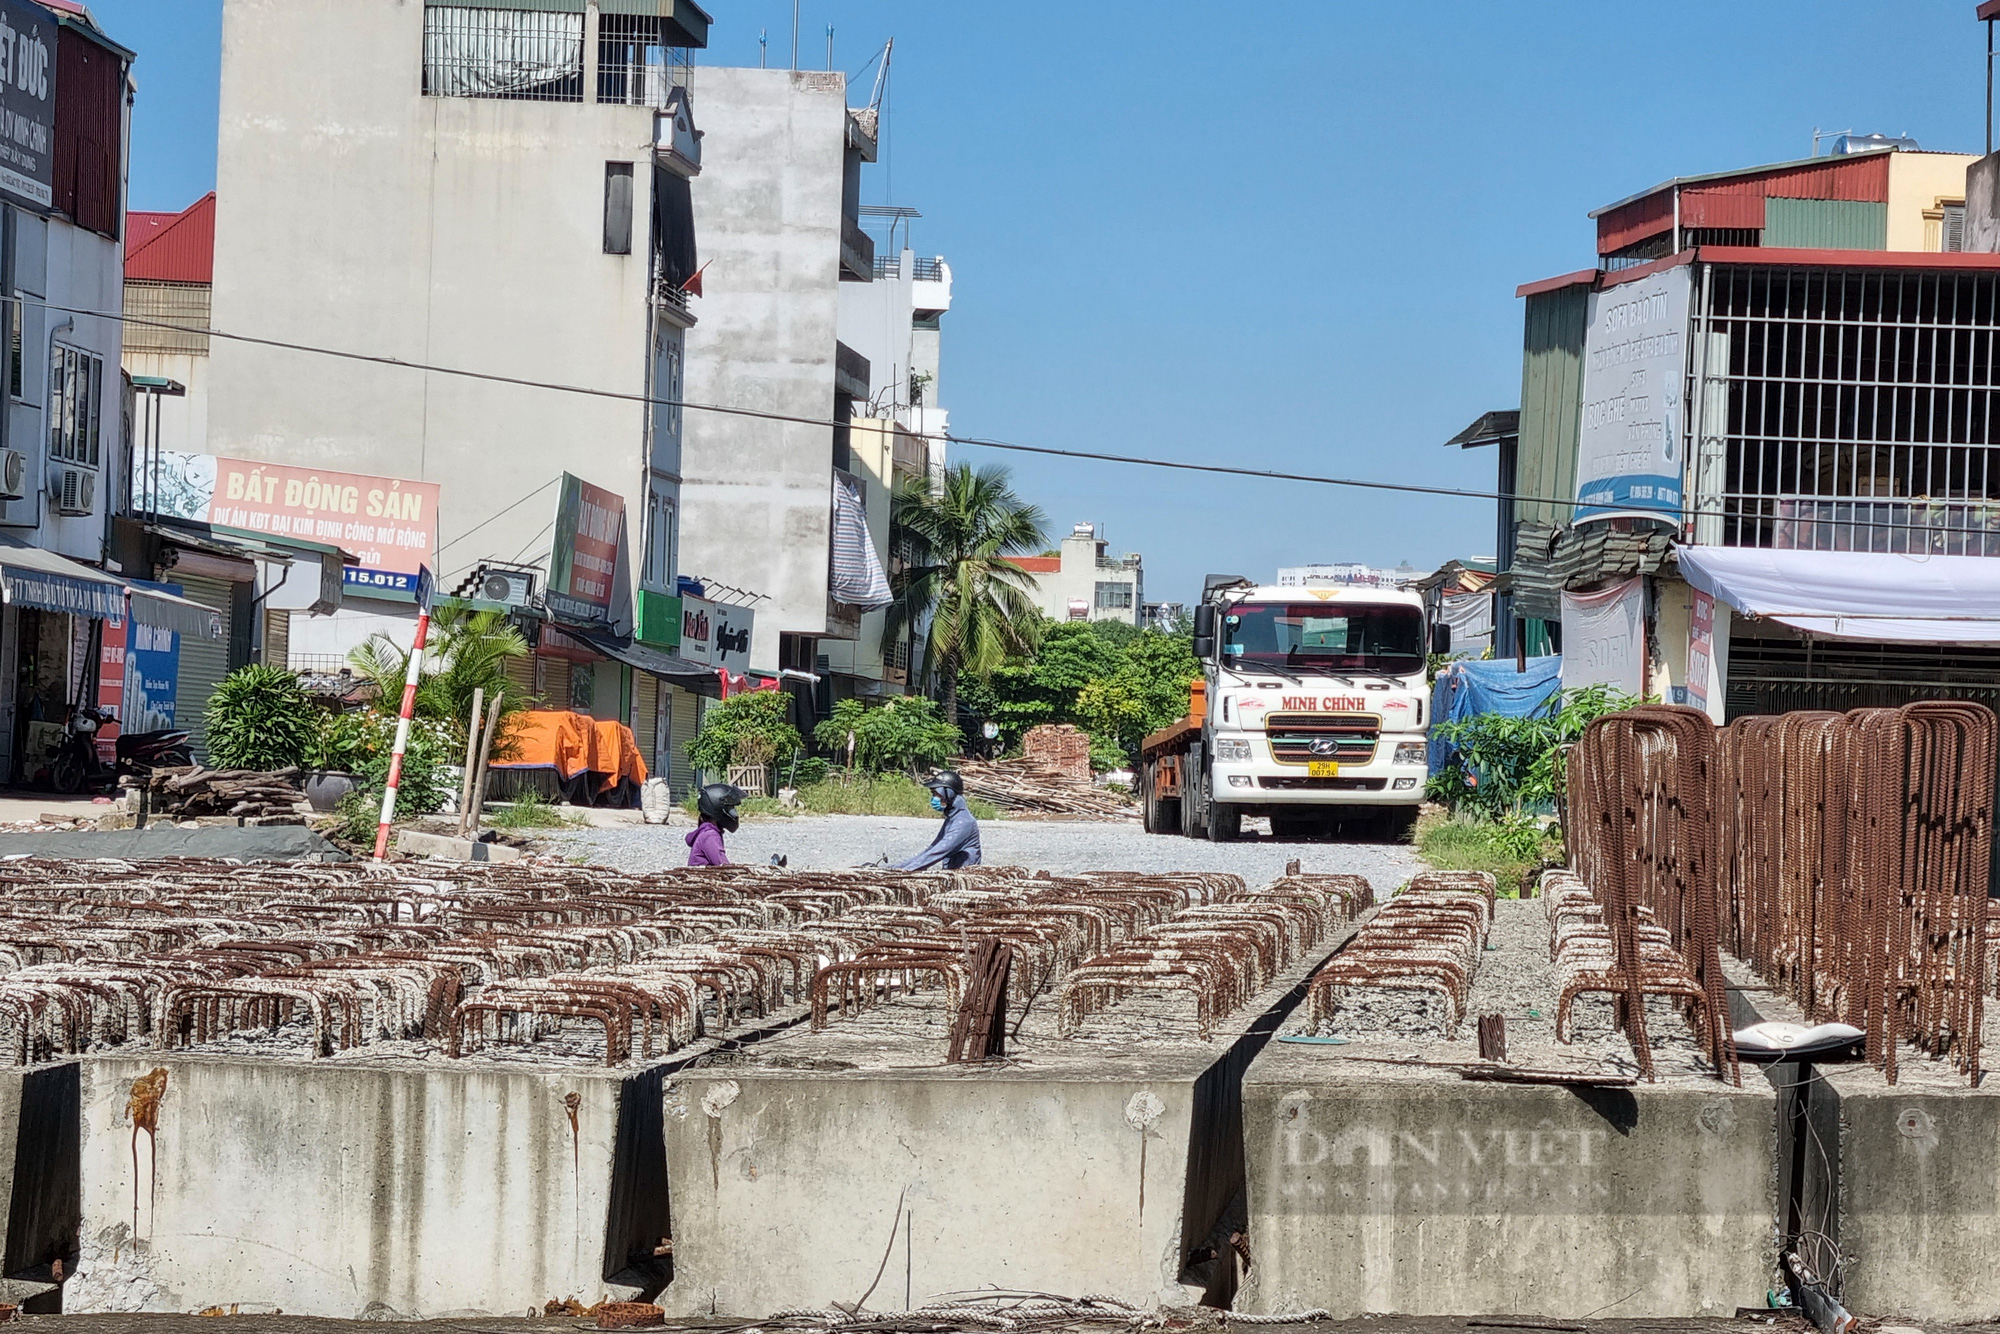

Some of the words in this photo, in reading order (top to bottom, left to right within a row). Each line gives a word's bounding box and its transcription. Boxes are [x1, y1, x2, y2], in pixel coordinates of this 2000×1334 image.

[18, 24, 48, 101] ĐỨC
[1605, 303, 1628, 334] SOFA
[1652, 287, 1668, 319] TÍN
[1587, 402, 1606, 431] BỌC
[1608, 386, 1626, 422] GHẾ
[226, 466, 279, 505] BẤT
[284, 476, 359, 515] ĐỘNG
[366, 480, 423, 521] SẢN
[231, 506, 248, 527] ÁN
[249, 511, 271, 530] KĐT
[272, 514, 292, 536] ĐẠI
[292, 516, 315, 535] KIM
[316, 520, 343, 541] ĐỊNH
[345, 521, 375, 542] CÔNG
[376, 521, 396, 544] MỞ
[396, 527, 427, 551] RỘNG
[1588, 634, 1629, 669] SOFA
[1689, 648, 1708, 691] SOFA
[1282, 696, 1317, 710] MINH
[1322, 693, 1366, 711] CHÍNH
